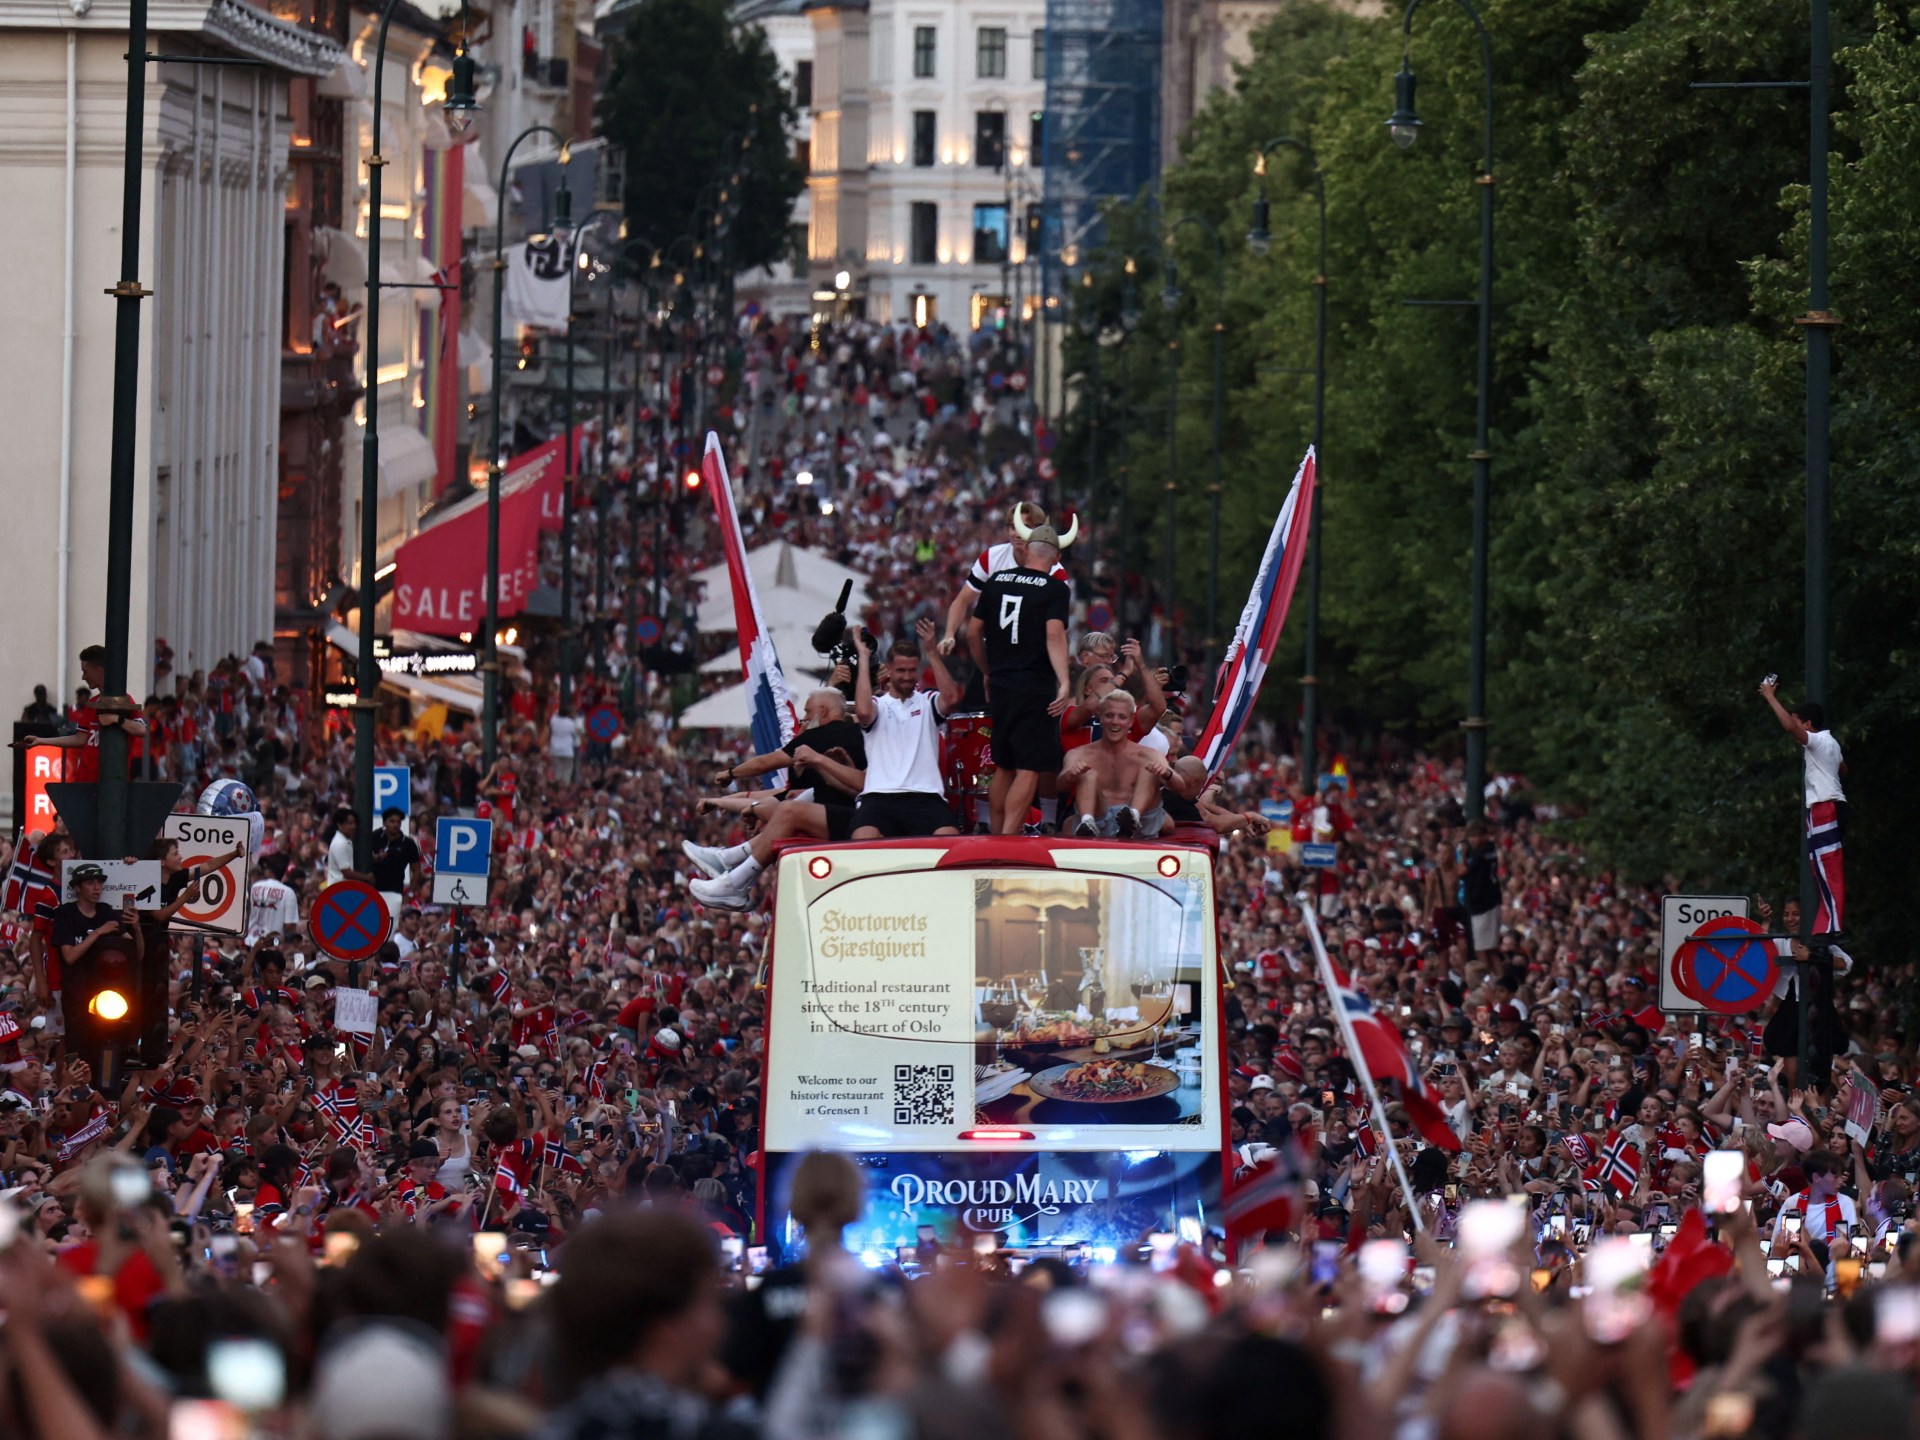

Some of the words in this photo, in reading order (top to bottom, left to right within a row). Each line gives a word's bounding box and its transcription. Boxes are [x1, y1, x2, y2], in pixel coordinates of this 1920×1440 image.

[397, 584, 473, 621] SALE
[999, 594, 1023, 644] 9
[87, 729, 99, 747] 20
[374, 773, 398, 810] P
[178, 822, 235, 844] Sone
[449, 825, 477, 866] P
[819, 908, 928, 933] Stortorvets
[820, 935, 926, 962] Gjæstgiveri
[801, 980, 877, 993] Traditional
[881, 982, 951, 993] restaurant
[801, 1001, 834, 1013] since
[838, 1000, 860, 1013] the
[898, 1003, 950, 1017] century
[810, 1021, 824, 1033] in
[828, 1021, 849, 1033] the
[853, 1020, 888, 1033] heart
[892, 1020, 907, 1033] of
[909, 1020, 942, 1033] Oslo
[797, 1075, 843, 1086] Welcome
[846, 1077, 857, 1086] to
[859, 1078, 878, 1086] our
[790, 1090, 829, 1100] historic
[831, 1092, 884, 1101] restaurant
[805, 1108, 815, 1116] at
[817, 1106, 860, 1116] Grensen
[863, 1106, 869, 1115] 1
[891, 1173, 1012, 1217] PROUD
[1014, 1173, 1100, 1209] MARY
[976, 1208, 1014, 1223] PUB
